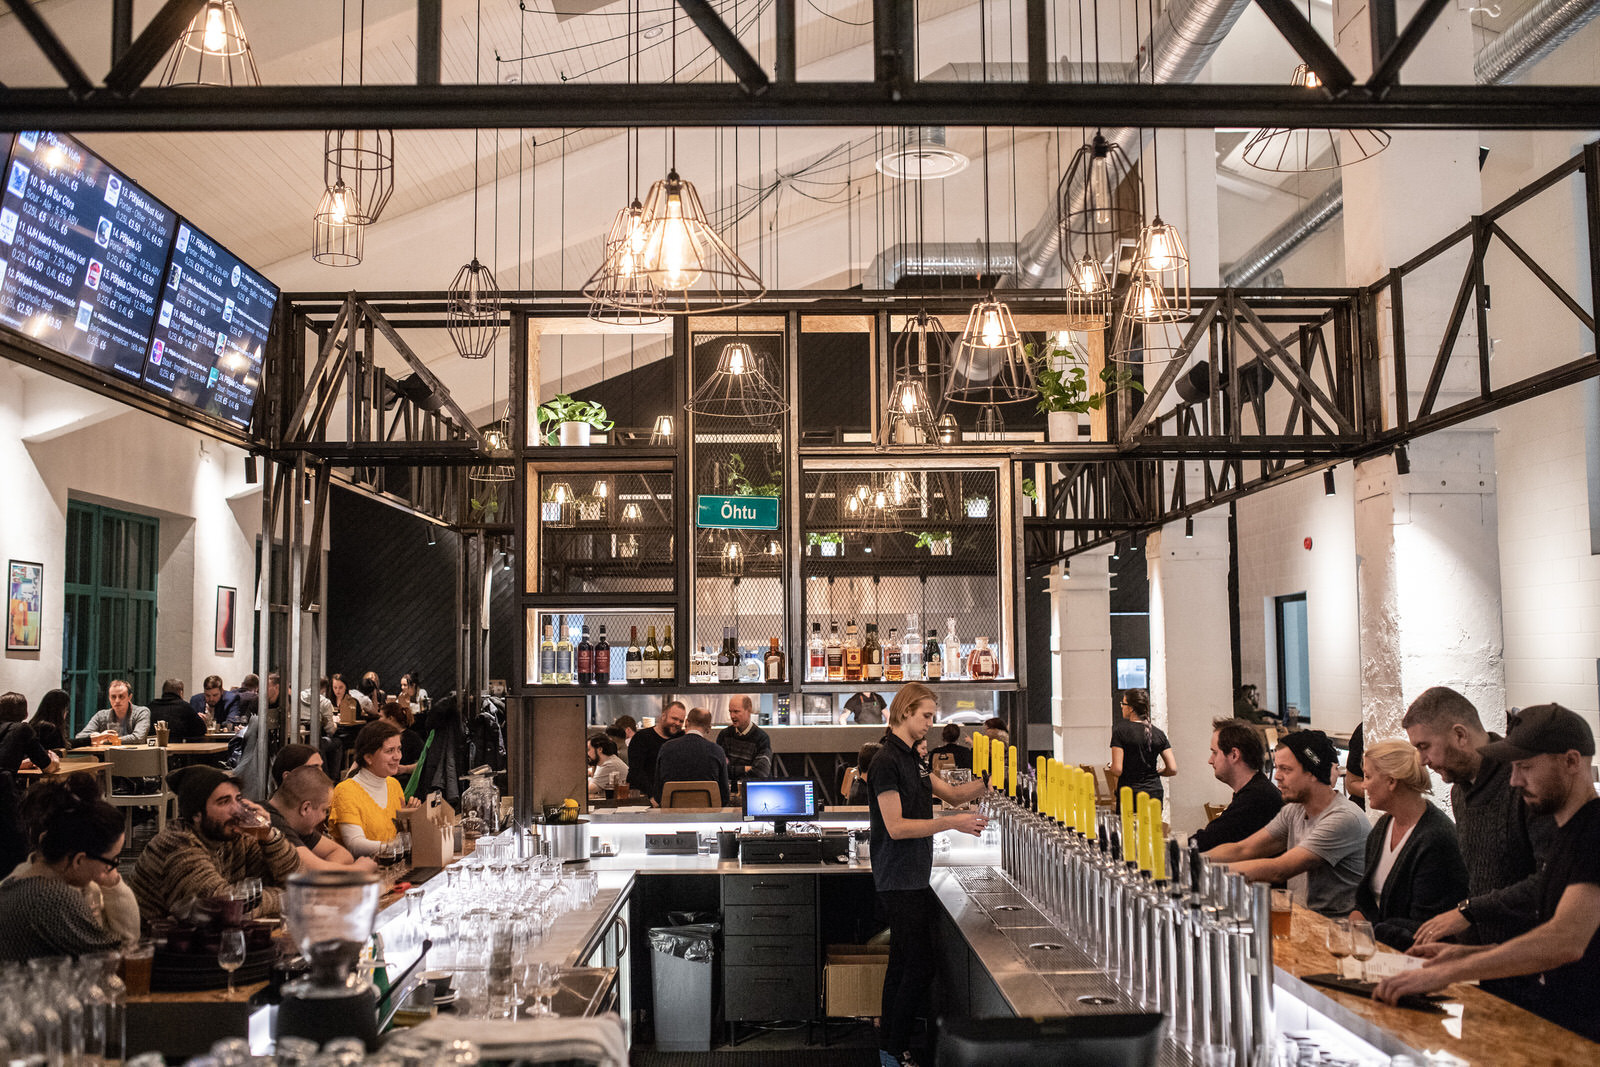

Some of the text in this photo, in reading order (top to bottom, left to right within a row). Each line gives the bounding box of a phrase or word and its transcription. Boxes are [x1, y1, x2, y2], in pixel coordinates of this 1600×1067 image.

[30, 174, 39, 187] 10.
[39, 180, 47, 192] To
[53, 190, 63, 203] Sur
[62, 195, 75, 210] Citra
[71, 180, 78, 192] €5
[26, 188, 39, 203] Sour
[43, 199, 52, 210] Ale
[68, 214, 79, 226] ABV
[119, 199, 132, 214] Porter
[135, 210, 146, 223] Other
[158, 225, 166, 237] ABV
[145, 202, 155, 215] Must
[39, 210, 47, 223] €5
[61, 224, 68, 235] €6
[129, 219, 140, 233] €3.50
[152, 234, 163, 248] €4.50
[19, 221, 27, 232] 11.
[52, 240, 64, 255] Royal
[15, 235, 25, 247] IPA
[28, 242, 50, 261] Imperial
[66, 262, 77, 275] ABV
[110, 240, 123, 254] Porter
[126, 250, 137, 263] Baltic
[152, 266, 160, 276] ABV
[28, 256, 44, 273] €4.50
[58, 272, 73, 287] €5.50
[119, 260, 131, 272] €4.50
[143, 273, 154, 286] €5.50
[33, 280, 54, 299] Rosemary
[54, 291, 76, 308] Lemonade
[101, 282, 112, 293] Stout
[114, 290, 131, 305] Imperial
[146, 306, 154, 316] ABV
[126, 282, 139, 297] Cherry
[17, 302, 33, 317] €2.50
[42, 299, 53, 311] Beer
[110, 300, 116, 309] €5
[721, 501, 756, 519] Õhtu
